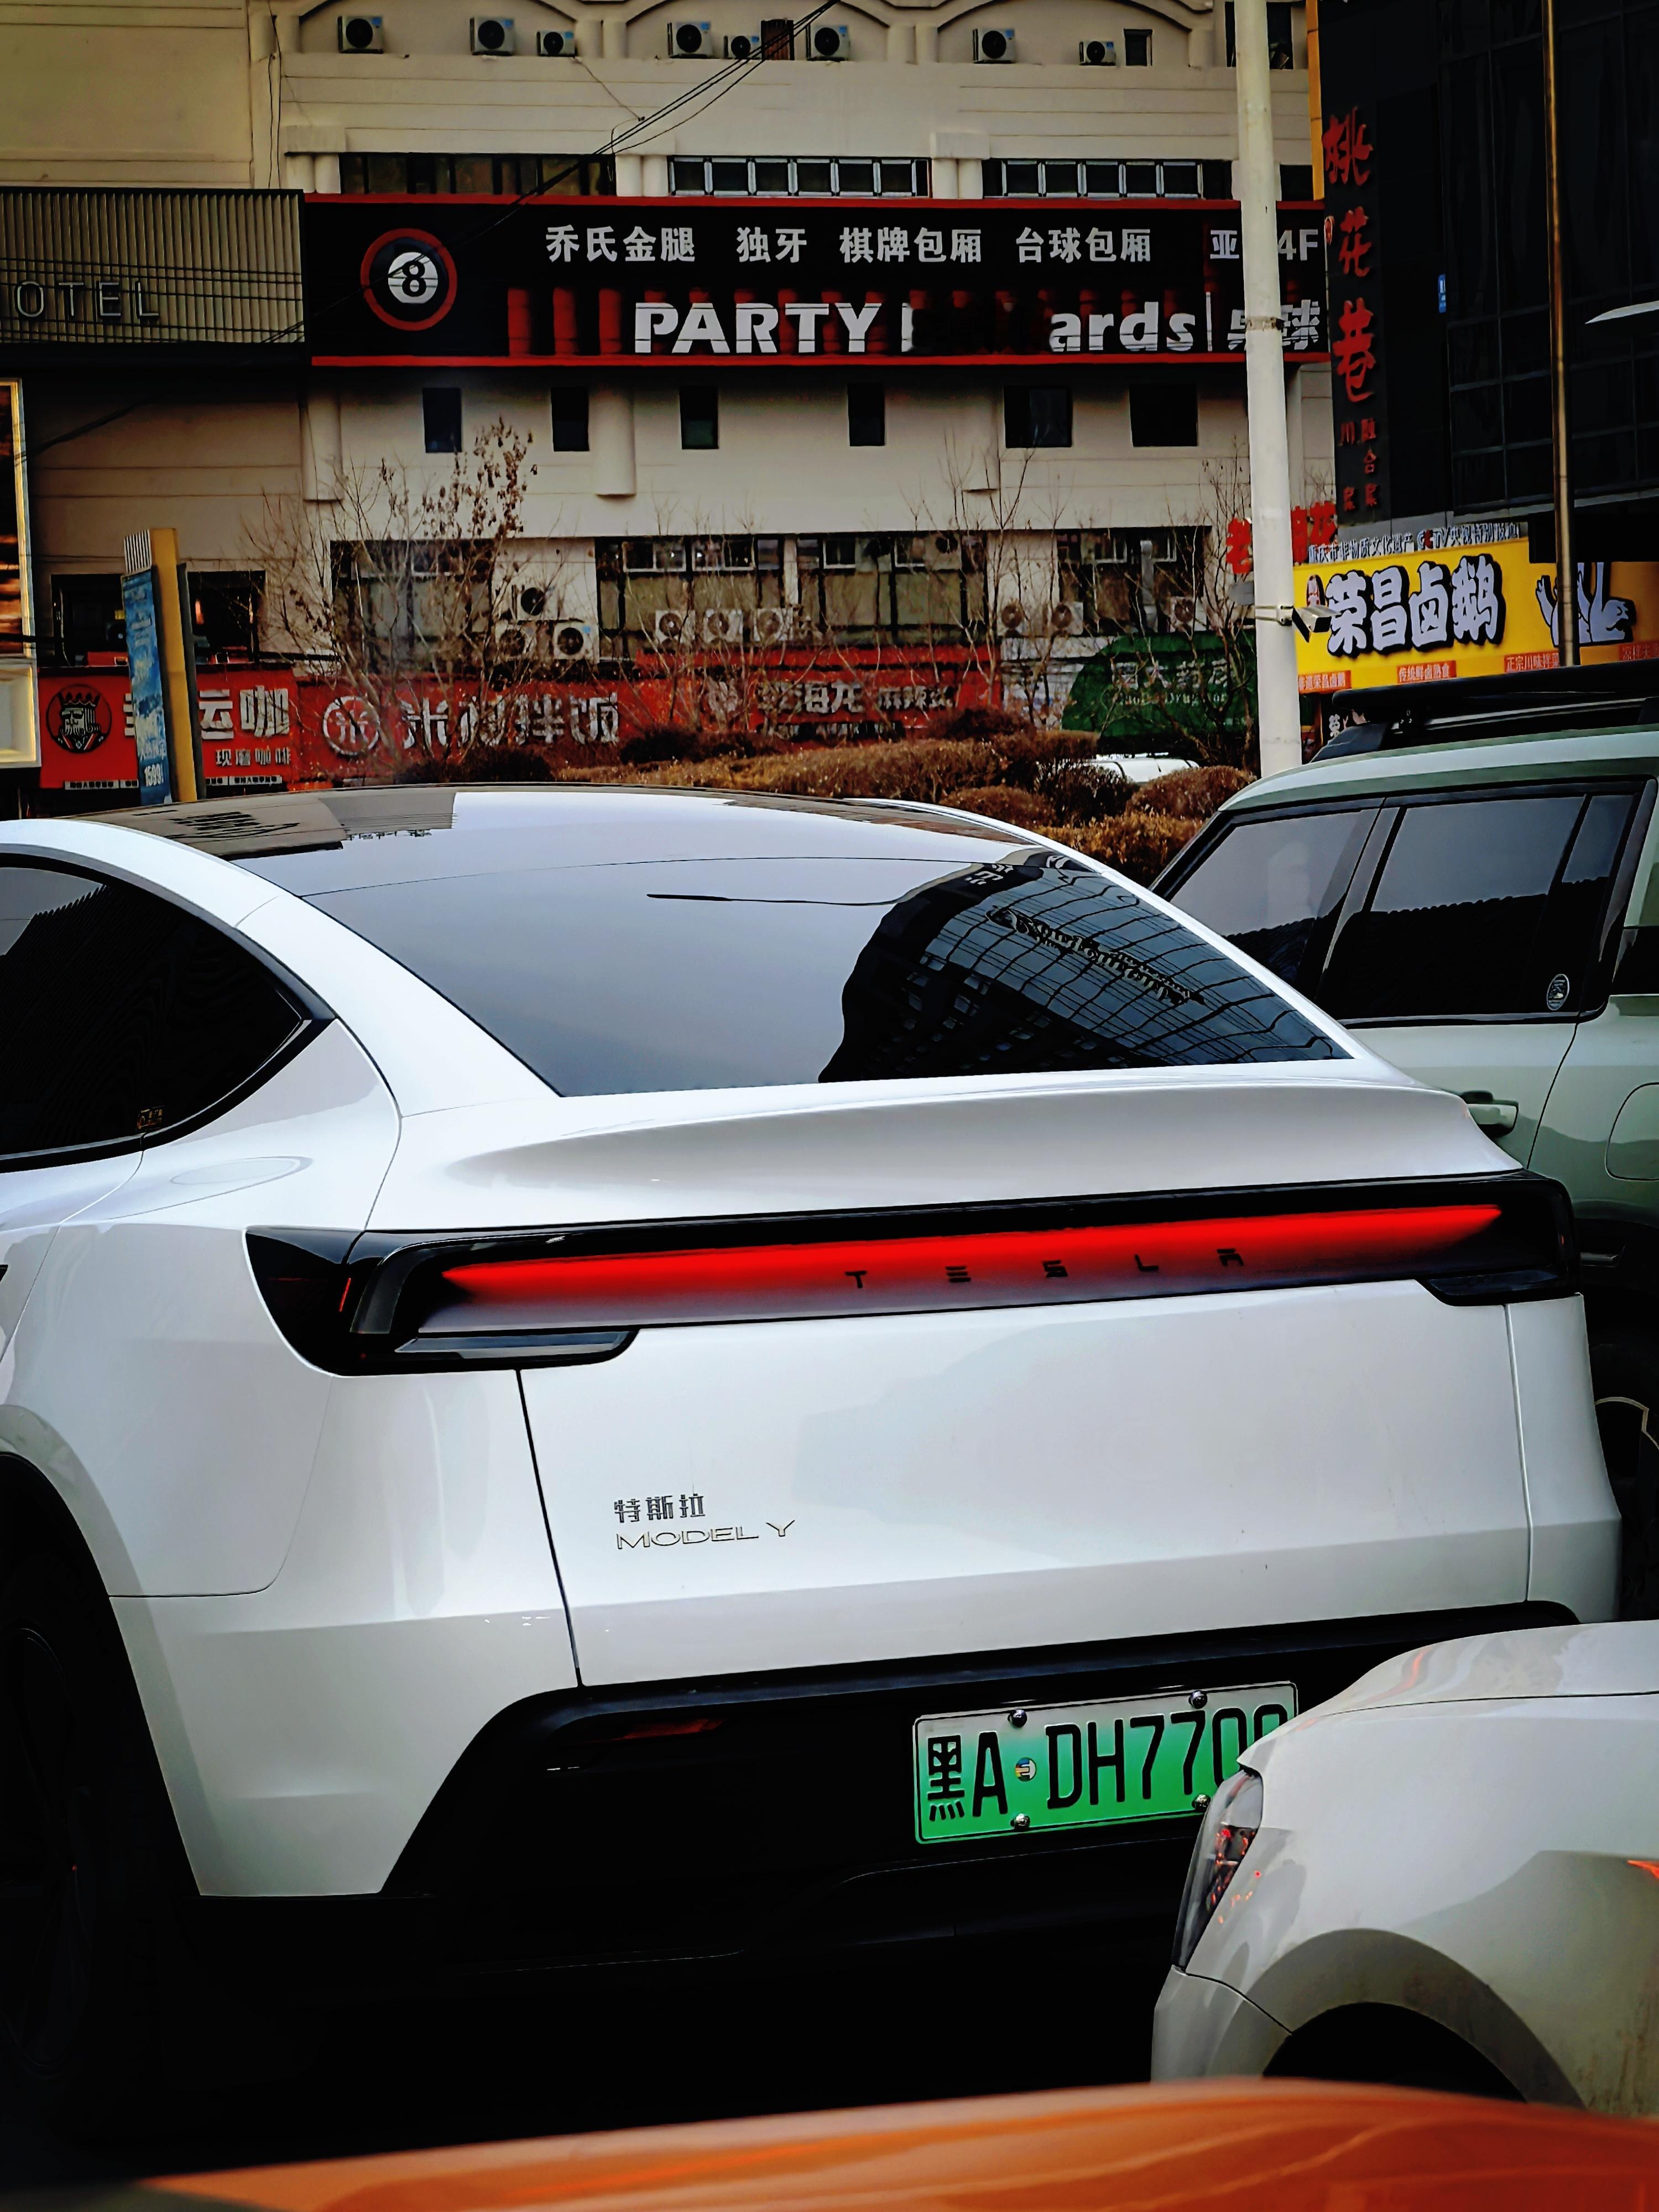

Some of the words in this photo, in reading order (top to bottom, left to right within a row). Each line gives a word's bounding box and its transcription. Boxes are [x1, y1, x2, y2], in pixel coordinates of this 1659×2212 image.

[545, 224, 695, 263] 乔氏金腿
[736, 226, 807, 263] 独牙
[839, 226, 982, 263] 棋牌包厢
[1016, 226, 1151, 263] 台球包厢
[1322, 105, 1376, 403] 桃花巷
[634, 302, 882, 353] PARTY
[1326, 554, 1504, 657] 荣昌卤鹅
[844, 1248, 1244, 1289] TESLA
[614, 1493, 706, 1524] 特斯拉
[615, 1526, 759, 1550] MODEL
[765, 1519, 796, 1537] Y
